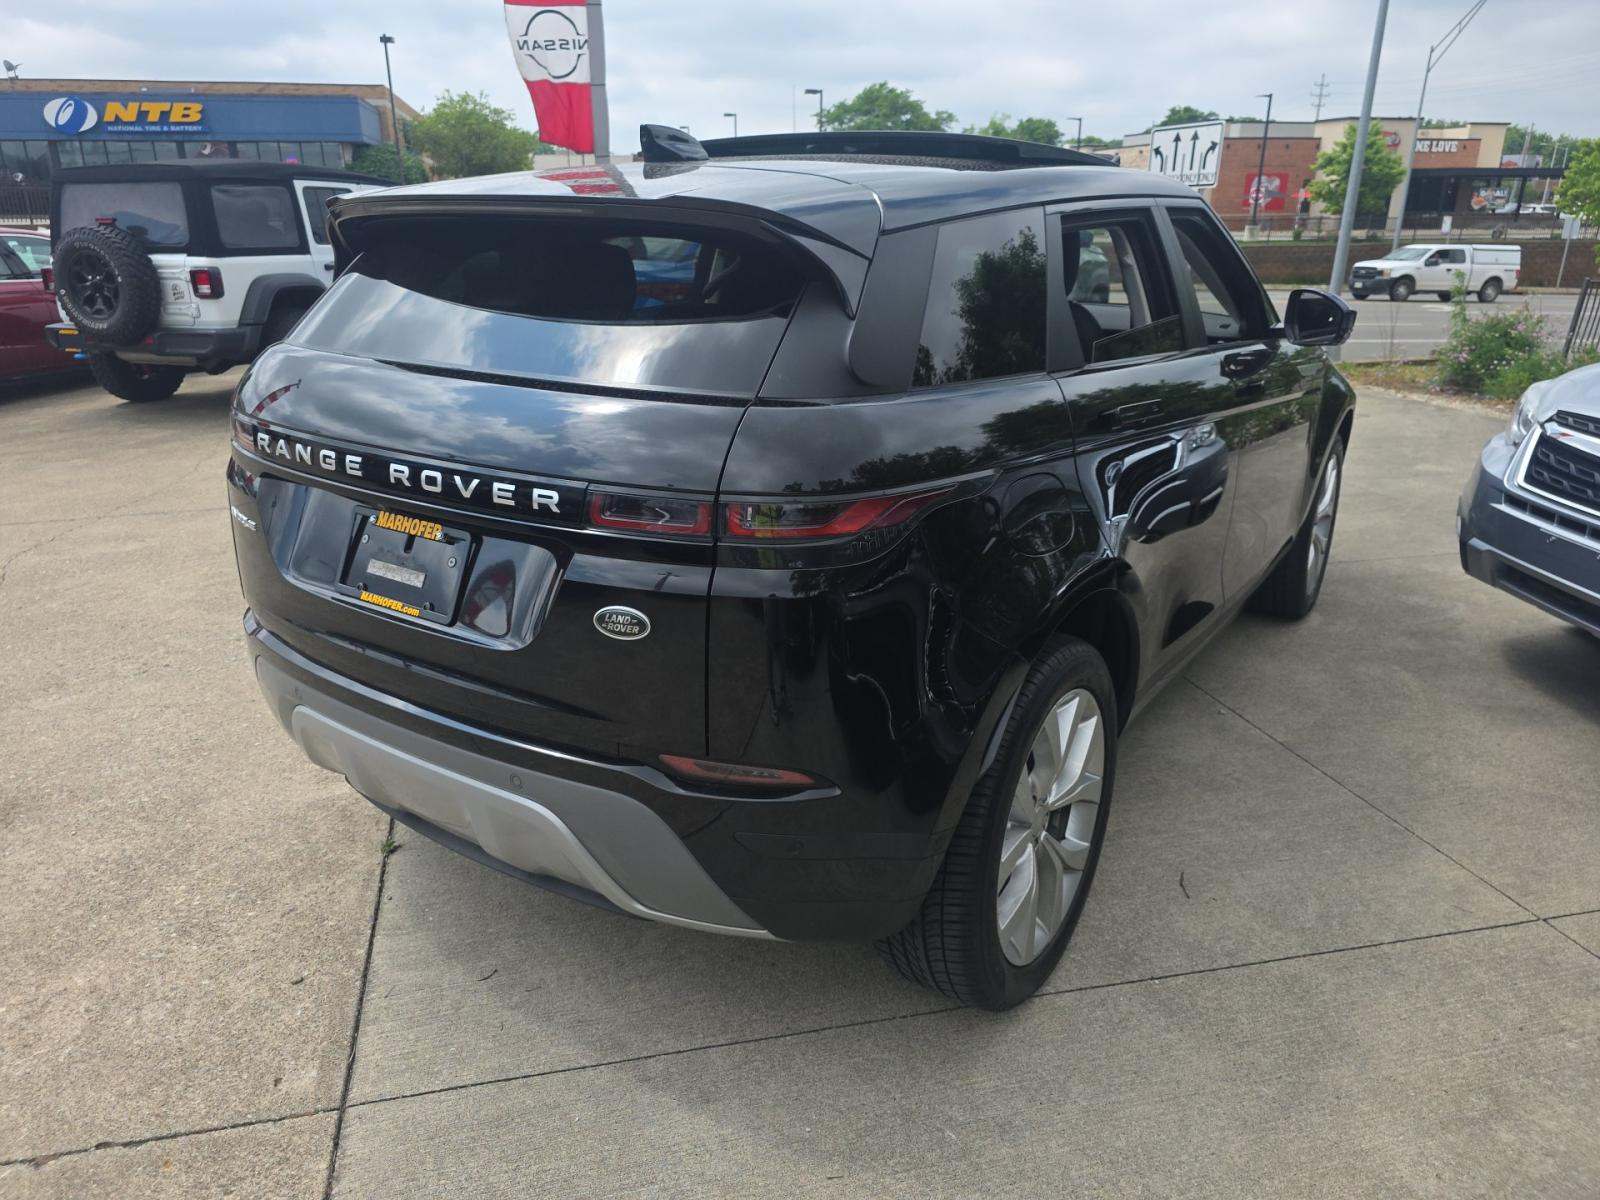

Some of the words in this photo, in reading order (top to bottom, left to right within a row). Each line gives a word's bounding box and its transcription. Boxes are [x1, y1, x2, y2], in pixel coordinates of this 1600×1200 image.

[103, 102, 204, 122] NTB
[1431, 140, 1458, 153] LOVE
[256, 432, 363, 477] RANGE
[389, 462, 561, 514] ROVER
[376, 510, 443, 540] MARHOFER
[360, 591, 420, 617] MARHOFER.com
[604, 613, 631, 625] LAND
[606, 622, 640, 634] ROVER
